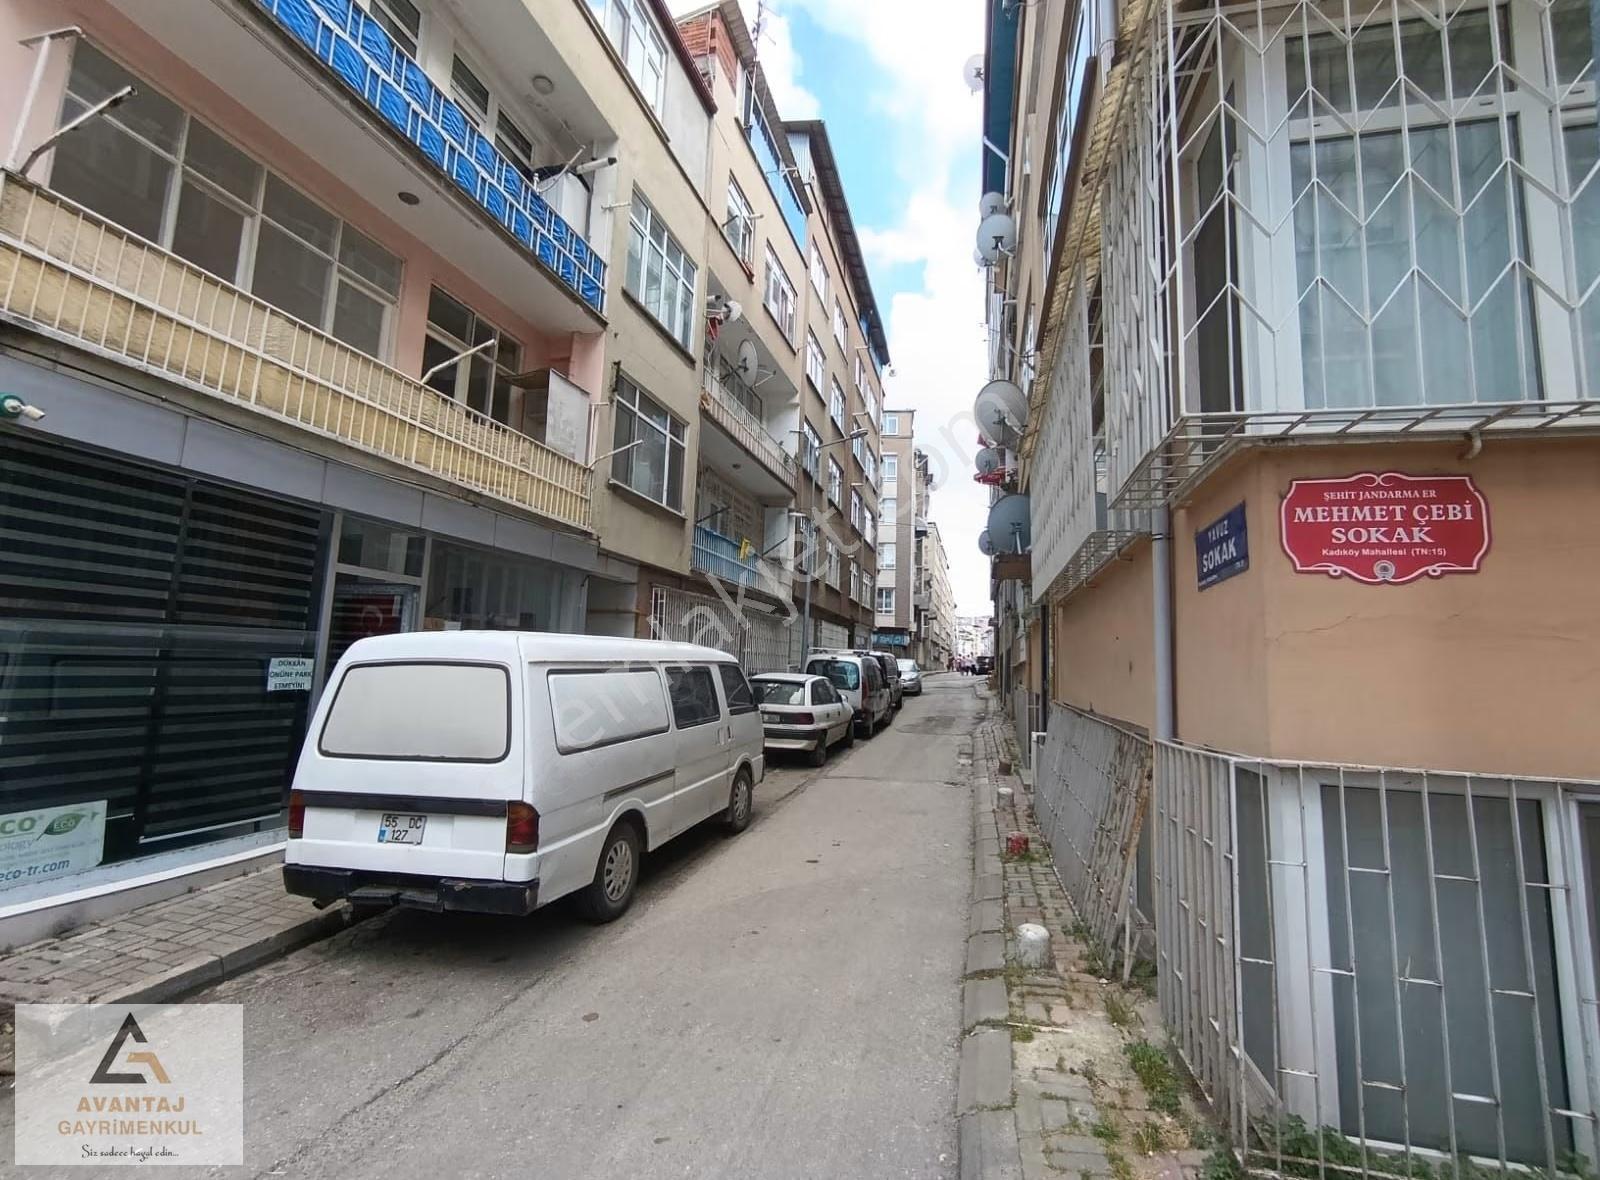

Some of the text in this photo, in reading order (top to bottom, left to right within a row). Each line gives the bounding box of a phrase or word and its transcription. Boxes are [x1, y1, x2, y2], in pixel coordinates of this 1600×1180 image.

[1323, 489, 1437, 501] ŞEHİT JANDARMA ER
[1293, 500, 1474, 525] MEHMET ÇEBİ
[1331, 526, 1435, 544] SOKAK
[1202, 536, 1237, 573] SOKAK
[1322, 547, 1447, 557] Kadıköy Mahallesi (TN:15)
[53, 818, 76, 832] ECO
[384, 815, 423, 830] 55 DC
[391, 829, 409, 841] 127
